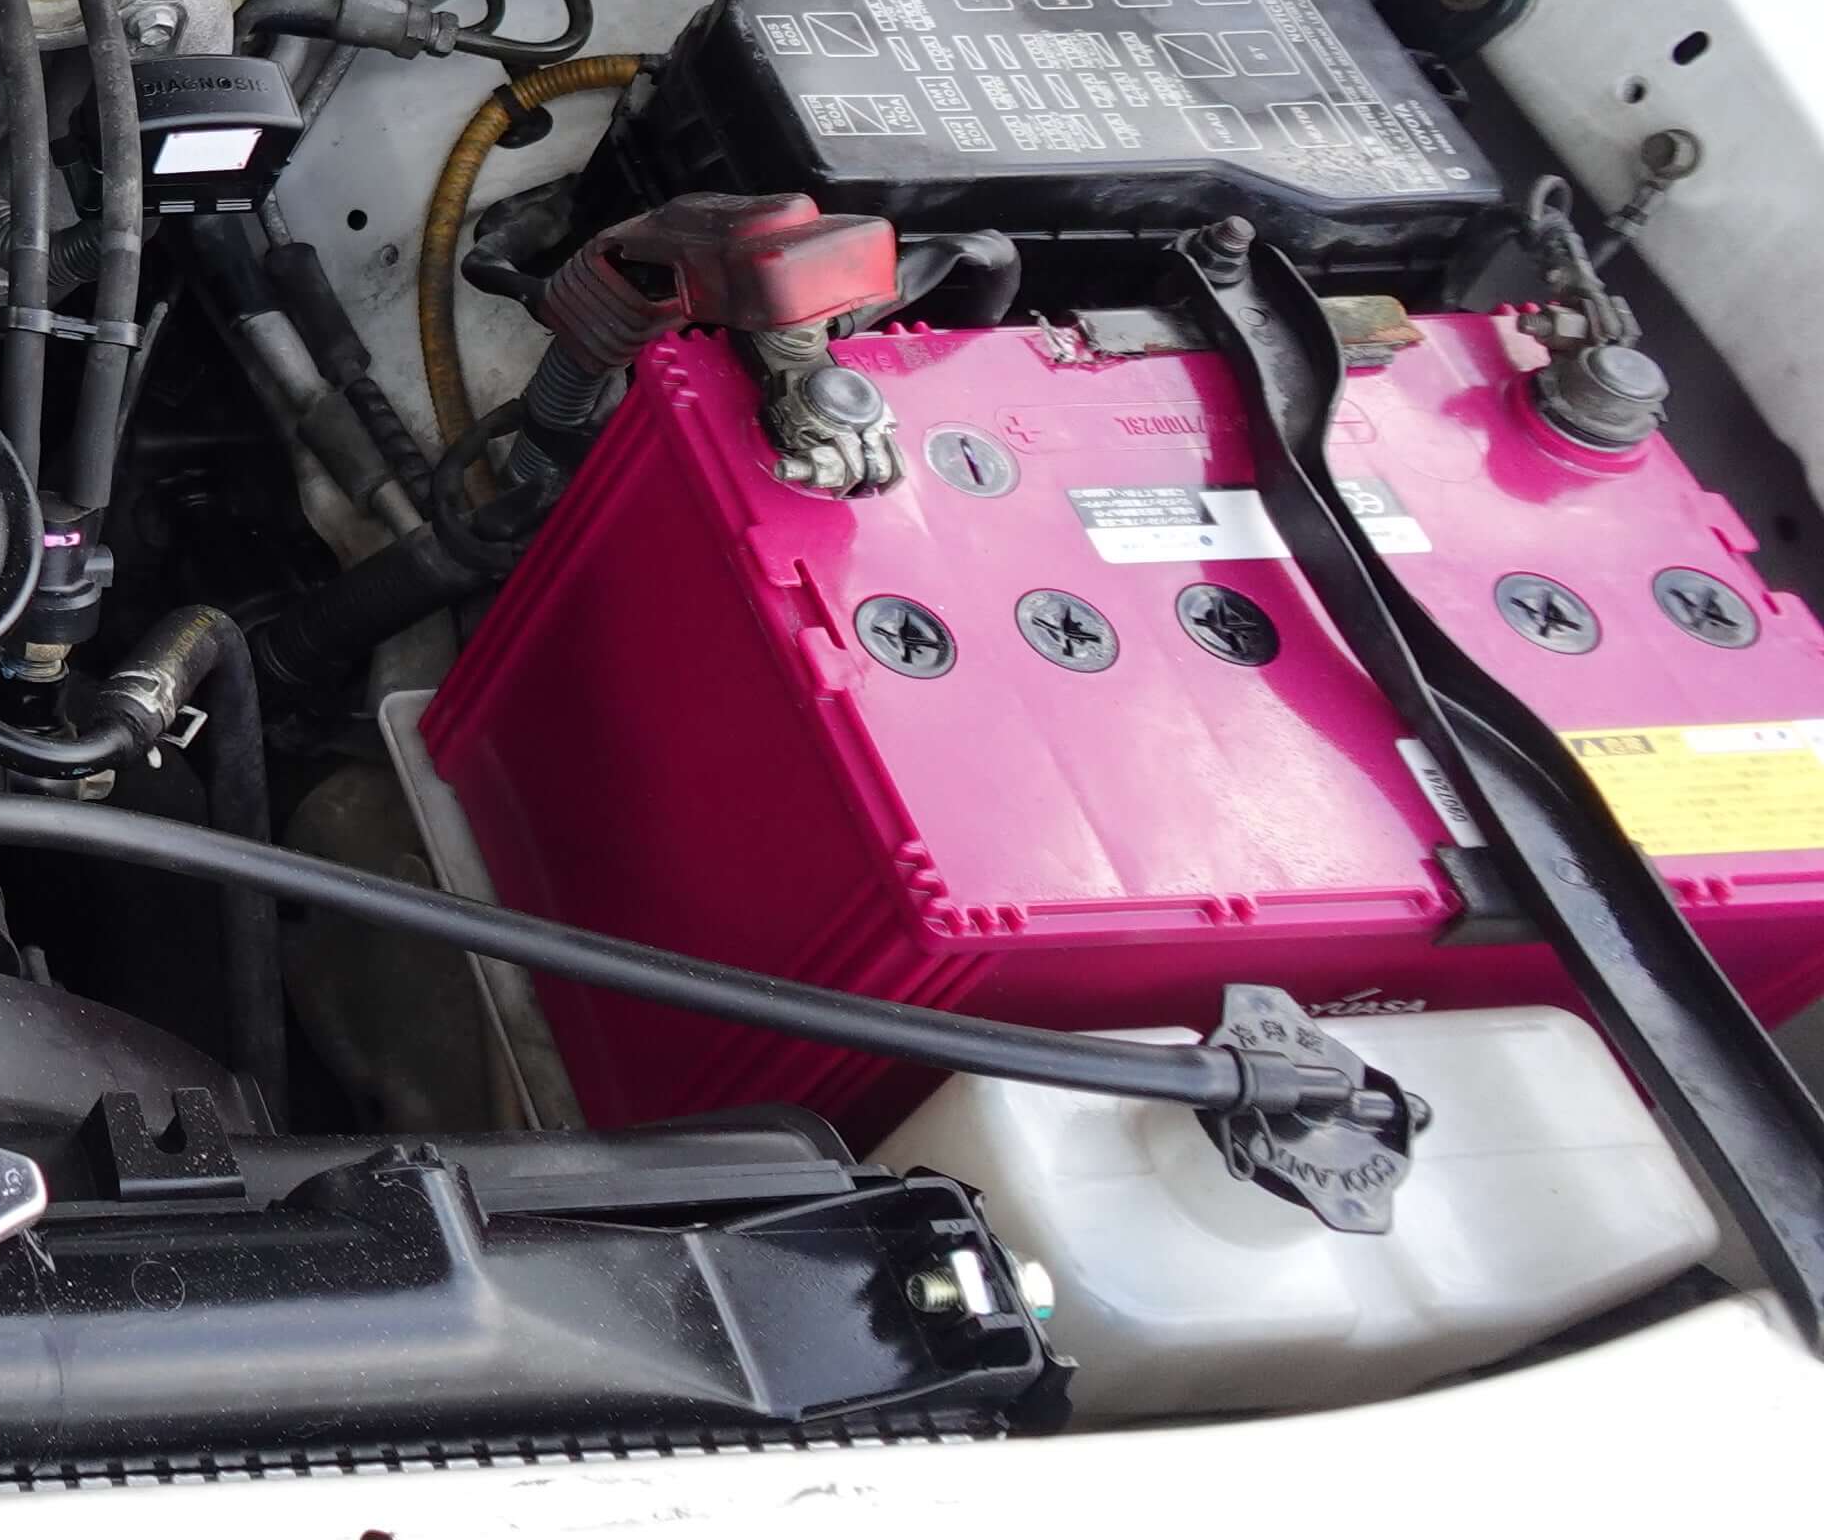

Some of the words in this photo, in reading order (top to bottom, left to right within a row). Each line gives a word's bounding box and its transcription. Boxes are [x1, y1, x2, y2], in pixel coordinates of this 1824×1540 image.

[765, 23, 790, 45] ABS
[924, 83, 950, 105] AM1
[877, 103, 901, 125] ALT
[887, 98, 918, 128] 100A
[948, 121, 975, 146] AM2
[961, 121, 988, 145] 30A
[1205, 112, 1235, 143] HEAD
[1391, 103, 1439, 151] TOYOTA
